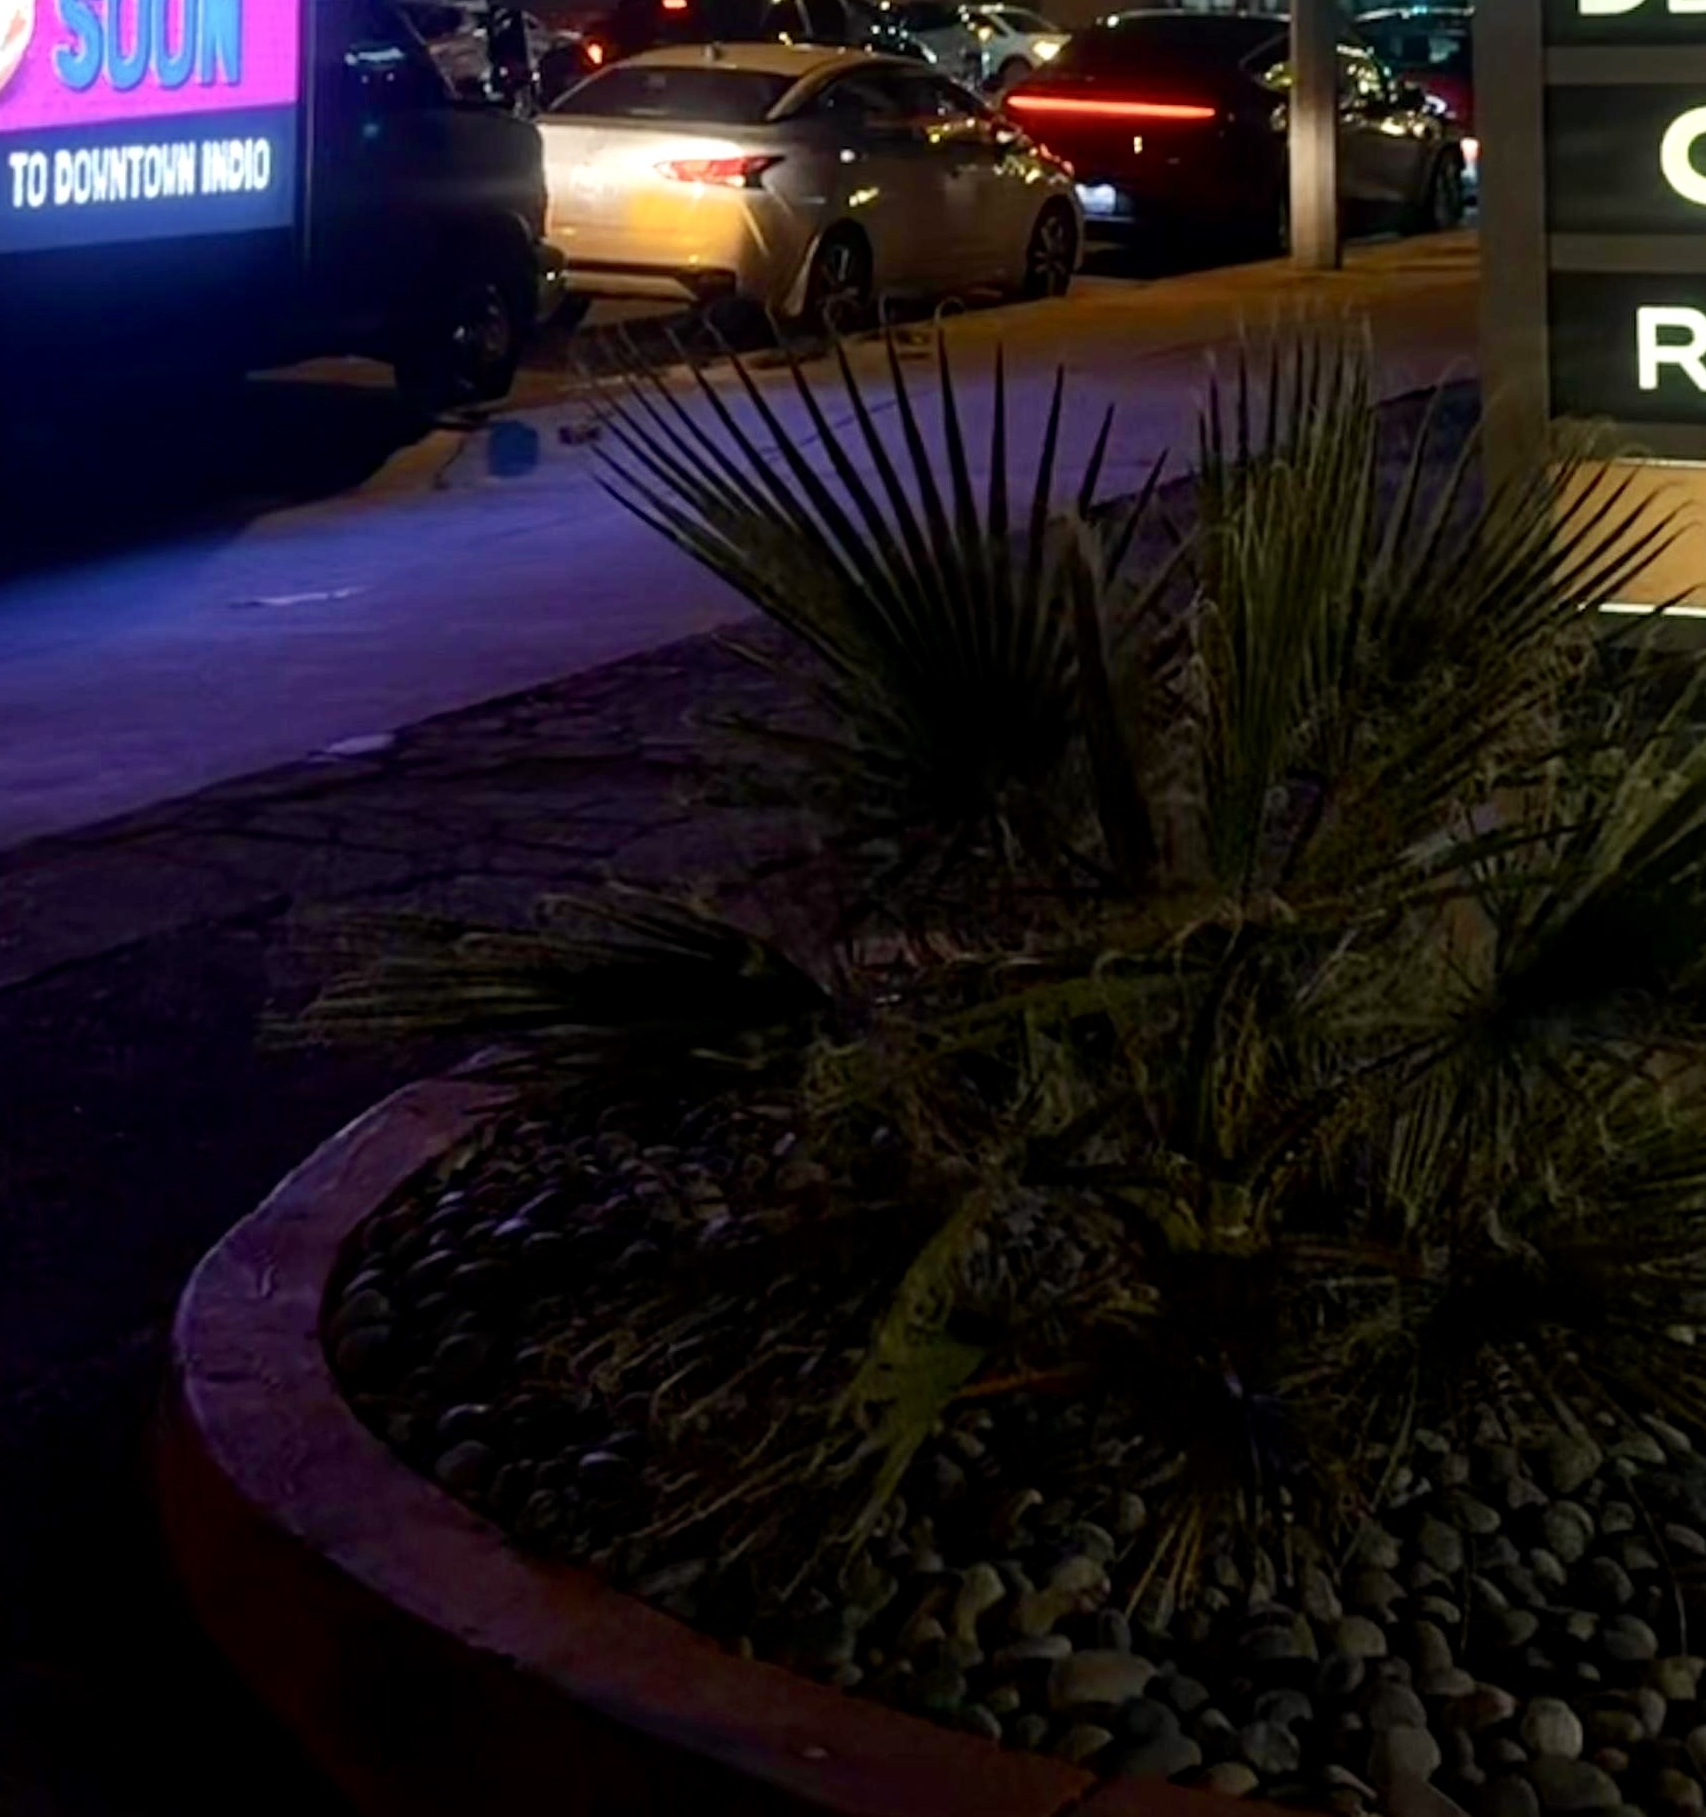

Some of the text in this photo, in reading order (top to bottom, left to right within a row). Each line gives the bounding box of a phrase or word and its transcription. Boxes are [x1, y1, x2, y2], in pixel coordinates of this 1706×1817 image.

[9, 137, 271, 208] TO DOWNTOWN INDIO
